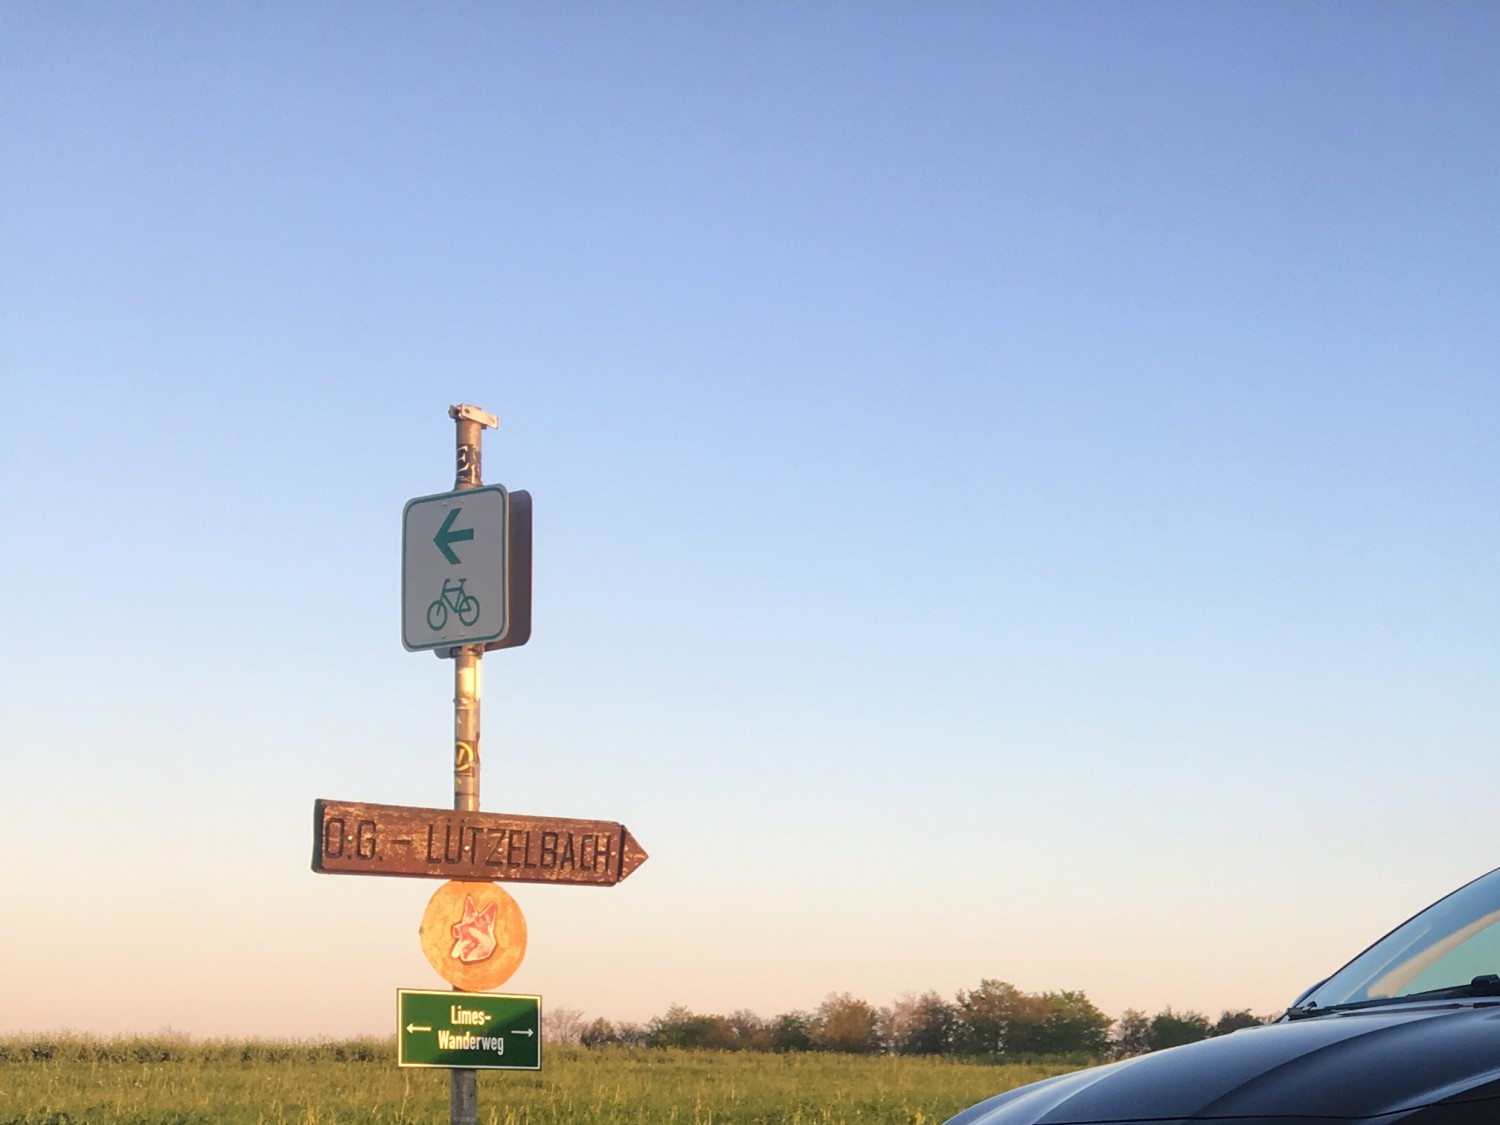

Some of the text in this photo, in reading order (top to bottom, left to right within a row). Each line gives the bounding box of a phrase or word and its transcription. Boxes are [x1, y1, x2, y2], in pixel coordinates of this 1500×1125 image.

[426, 818, 612, 872] LÜTZELBACH
[450, 1005, 492, 1026] Limes-
[438, 1030, 505, 1056] Wanderweg
